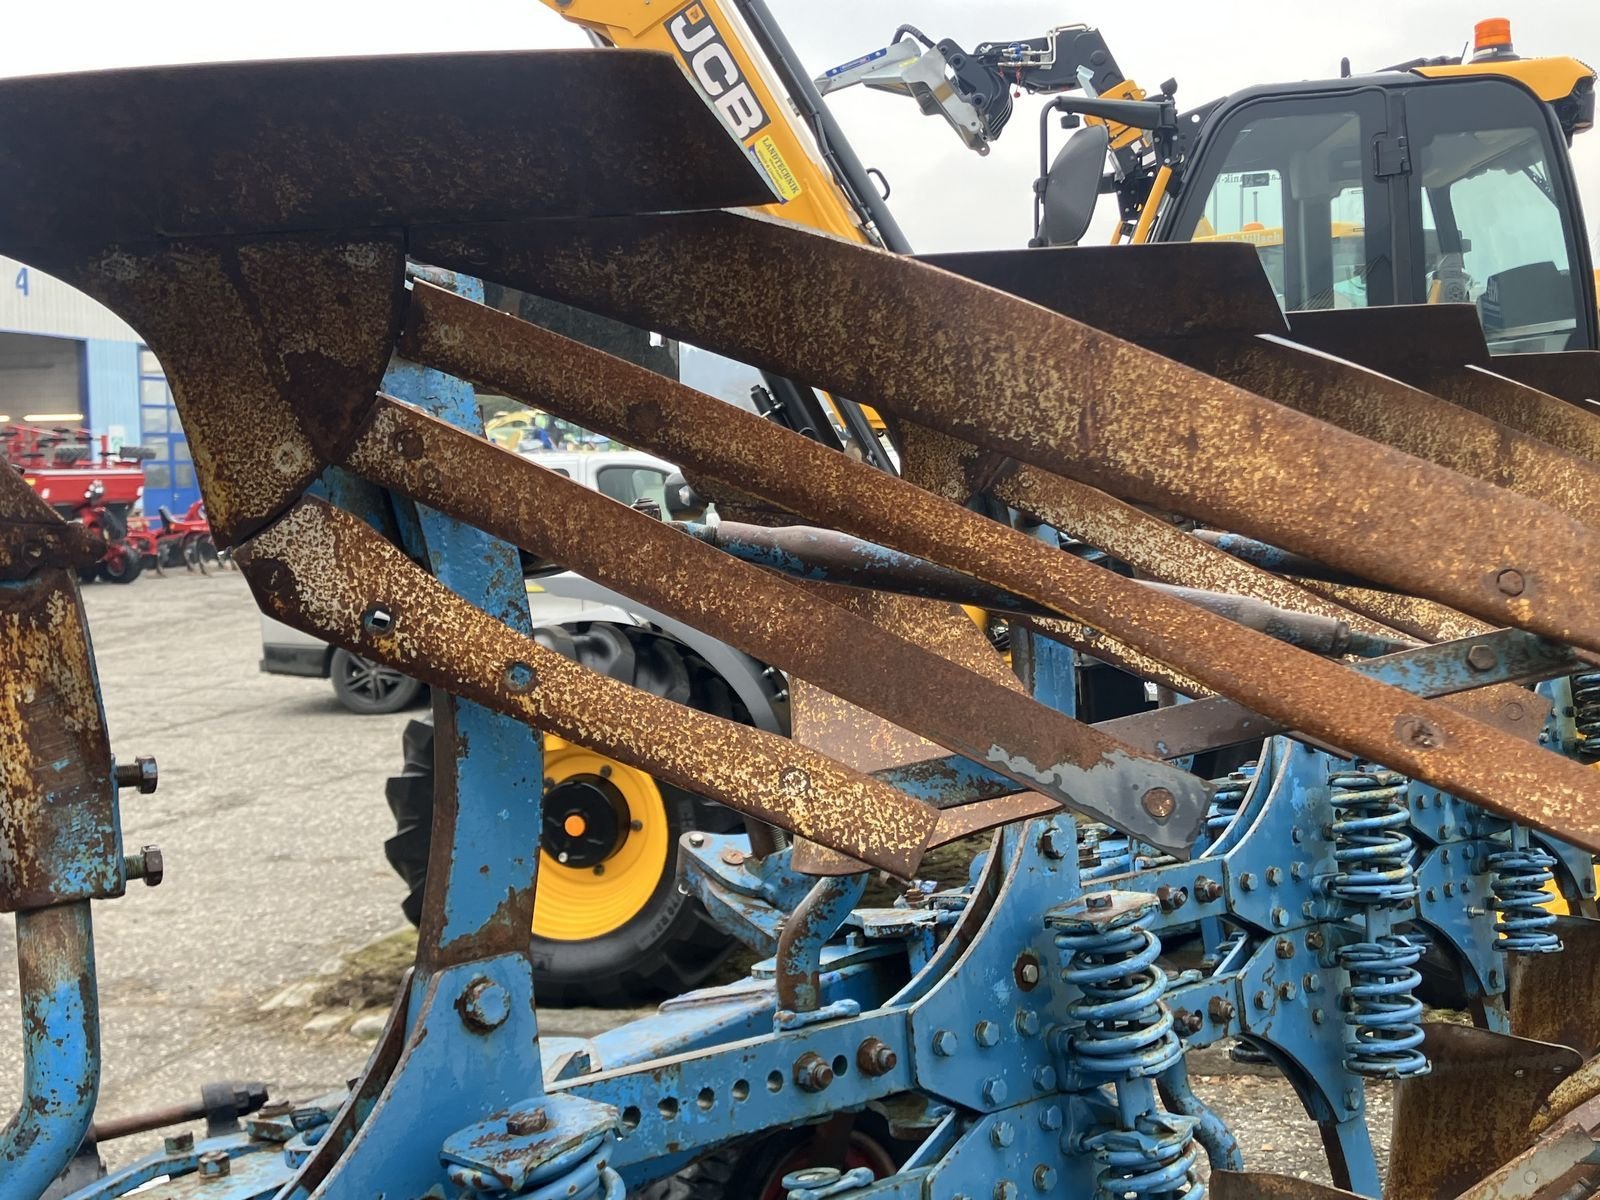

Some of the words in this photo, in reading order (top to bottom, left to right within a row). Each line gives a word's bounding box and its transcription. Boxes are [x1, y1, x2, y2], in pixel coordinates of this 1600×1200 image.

[670, 15, 763, 139] JCB
[763, 137, 799, 194] LANDTECHNIK
[15, 267, 29, 295] 4
